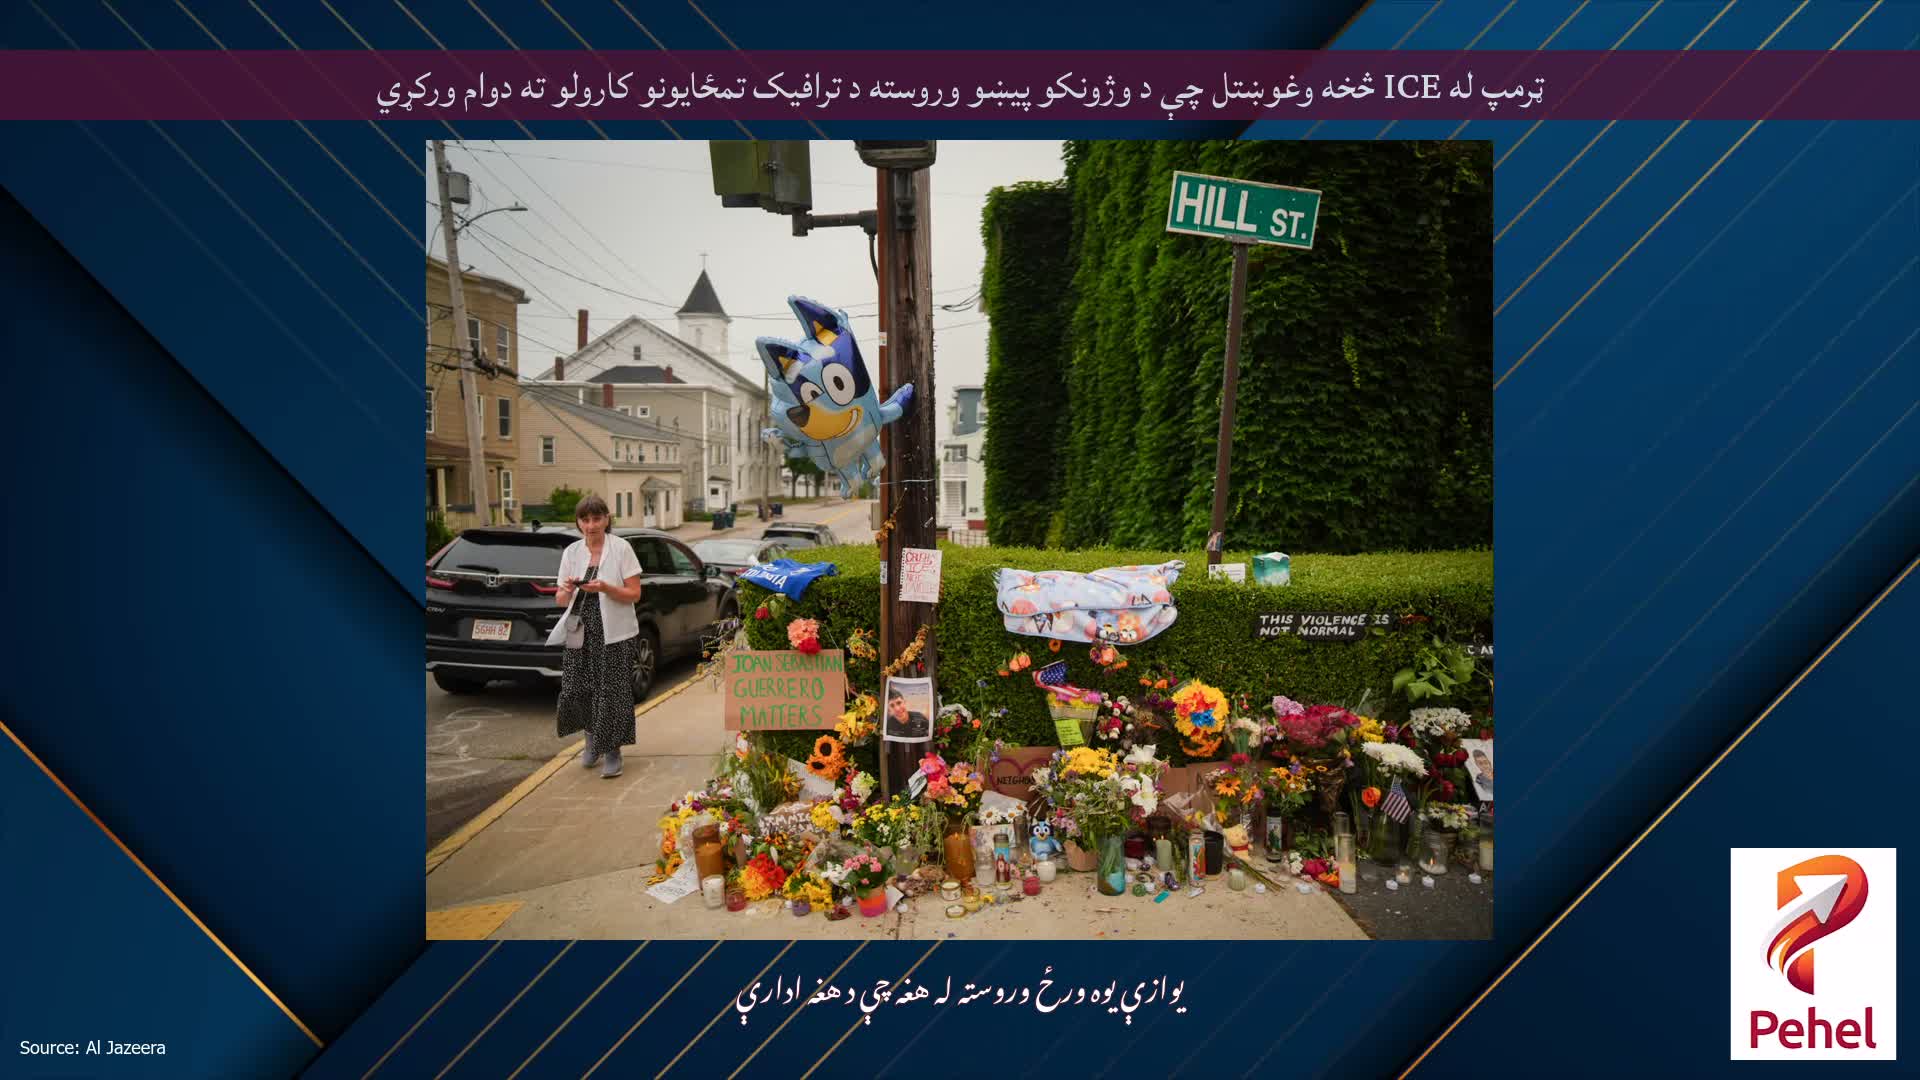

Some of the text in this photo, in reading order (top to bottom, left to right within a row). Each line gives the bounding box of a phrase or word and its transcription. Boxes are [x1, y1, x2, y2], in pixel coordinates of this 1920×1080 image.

[1176, 181, 1307, 239] HILL ST.
[1260, 613, 1390, 626] THIS VIOLENCE IS
[1259, 626, 1356, 636] NOT NORMAL
[731, 653, 843, 673] JOAN SEBASTIAN
[733, 677, 825, 700] GUERRERO
[740, 703, 824, 728] MATTERS
